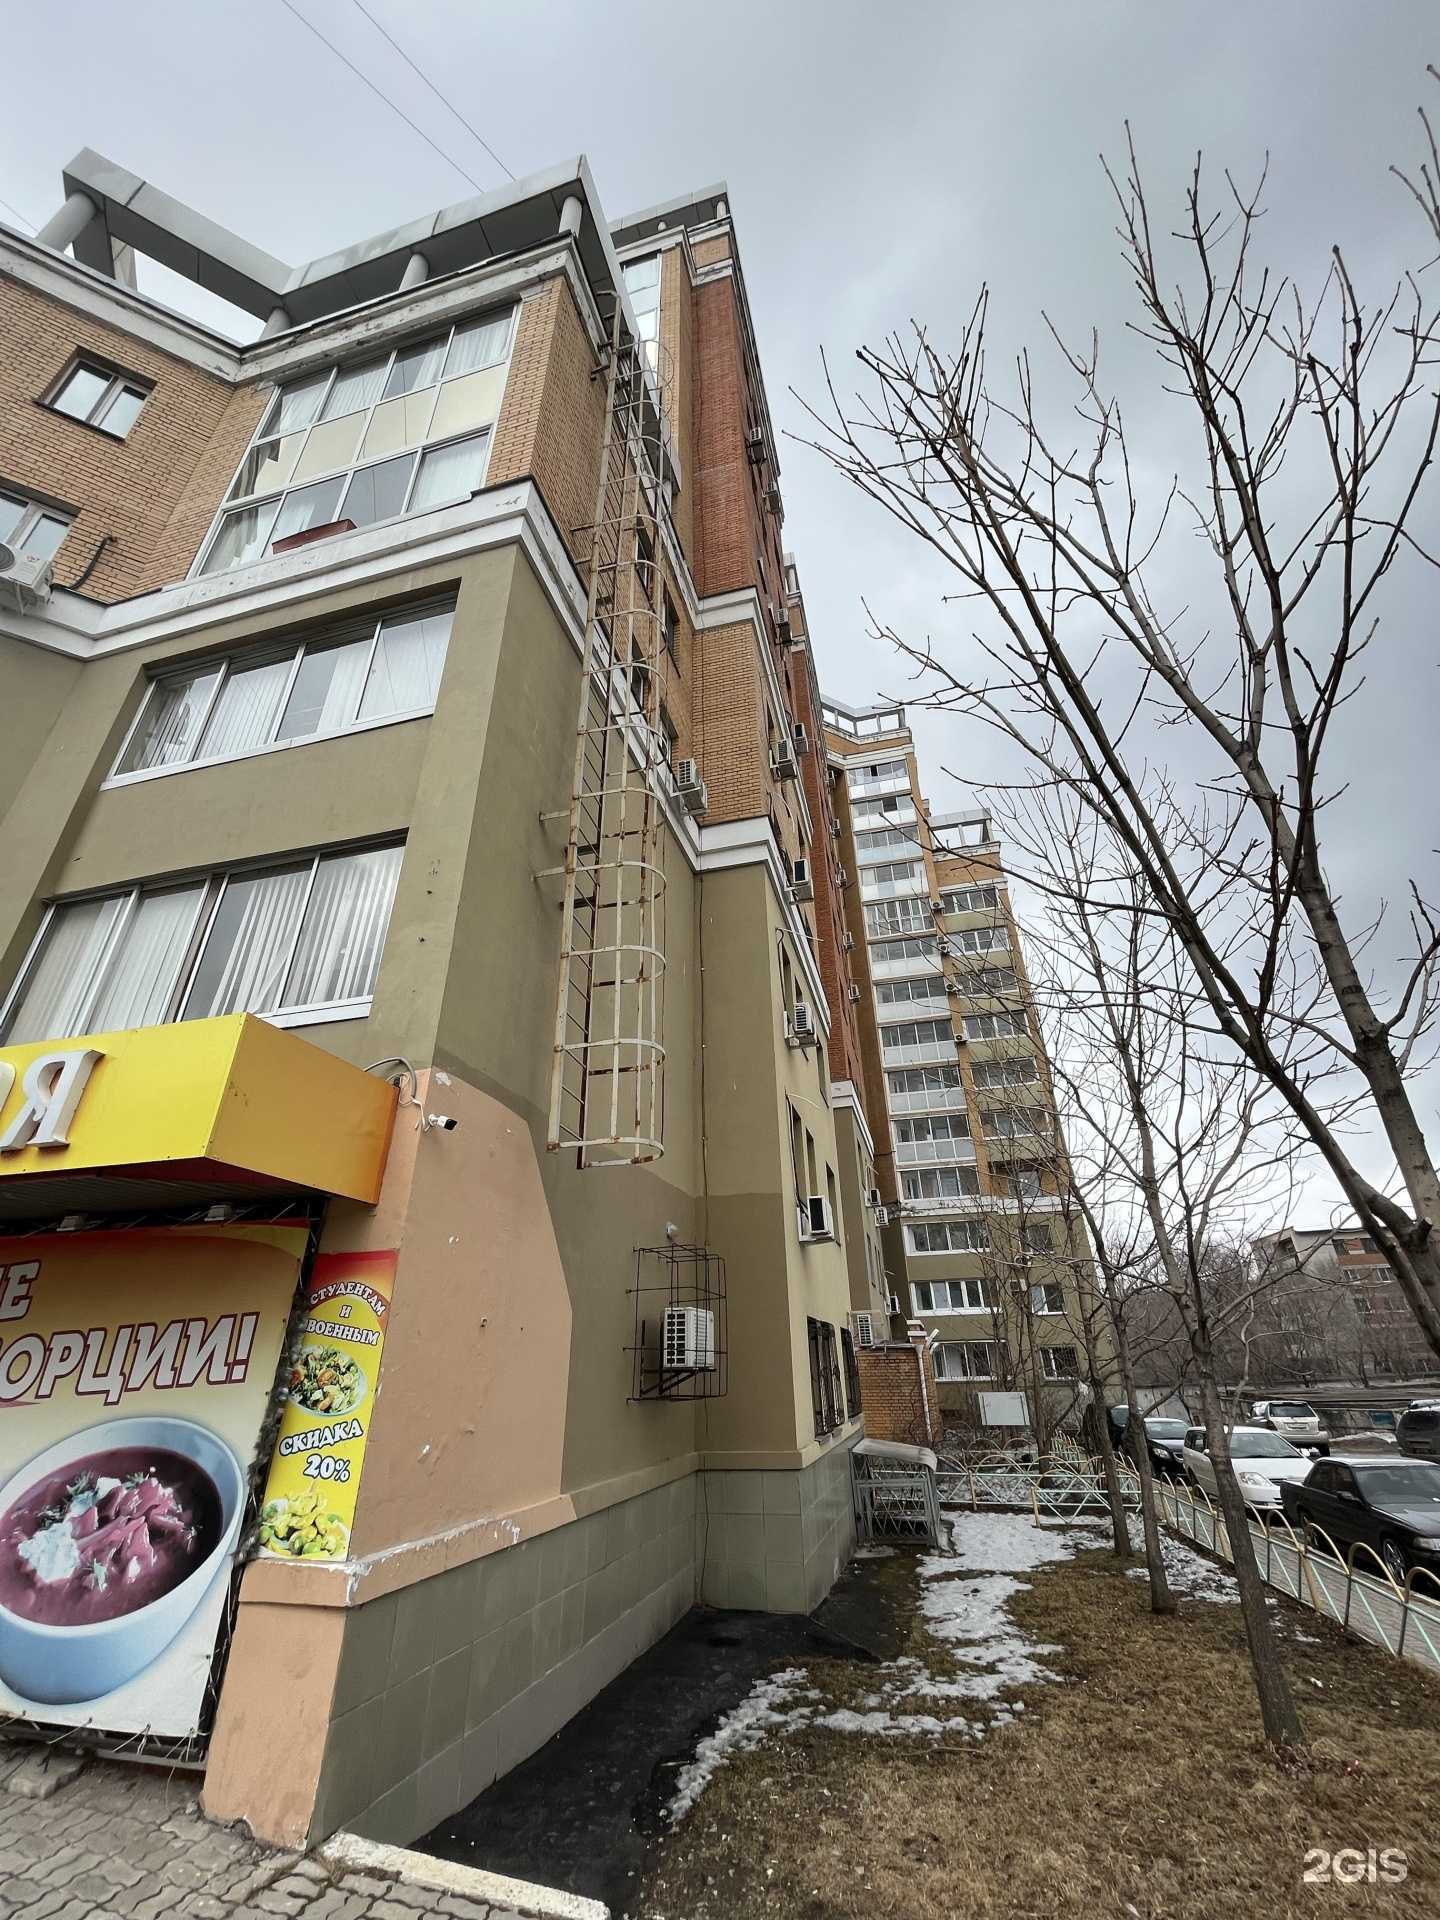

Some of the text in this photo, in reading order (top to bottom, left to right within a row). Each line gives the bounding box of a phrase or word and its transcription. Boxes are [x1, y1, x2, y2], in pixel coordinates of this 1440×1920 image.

[0, 1050, 105, 1151] Я
[0, 1259, 41, 1322] Е
[310, 1282, 386, 1317] СТУДЕНТАМ
[339, 1305, 352, 1318] И
[304, 1319, 380, 1346] ВОЕННЫМ
[0, 1312, 260, 1406] ОРЦИИ!
[279, 1418, 364, 1456] СКИДКА
[303, 1453, 351, 1483] 20%
